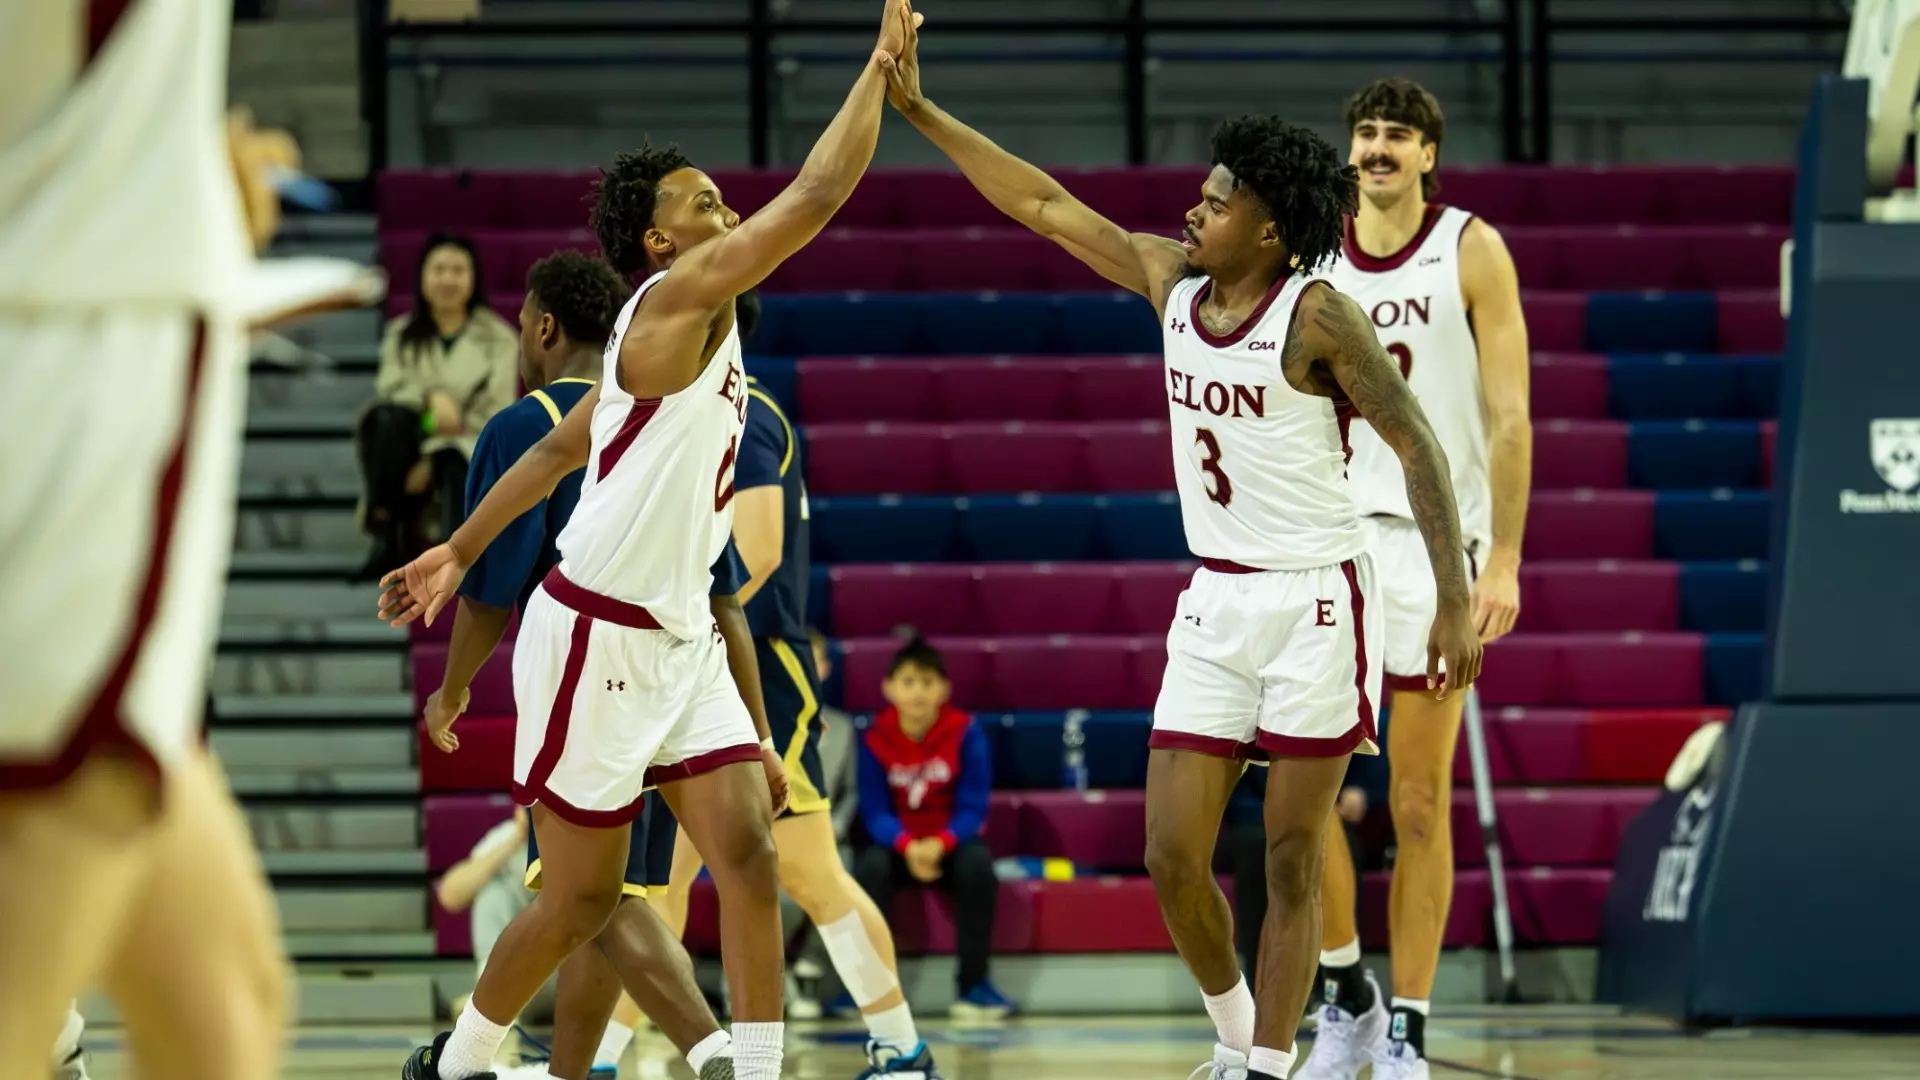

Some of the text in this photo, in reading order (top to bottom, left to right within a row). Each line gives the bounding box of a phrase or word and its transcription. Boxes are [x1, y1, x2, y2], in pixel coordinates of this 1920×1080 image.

[1371, 295, 1432, 328] ON
[1247, 341, 1276, 351] CAA
[1169, 367, 1267, 418] ELON
[1194, 427, 1234, 510] 3
[1315, 599, 1337, 627] E
